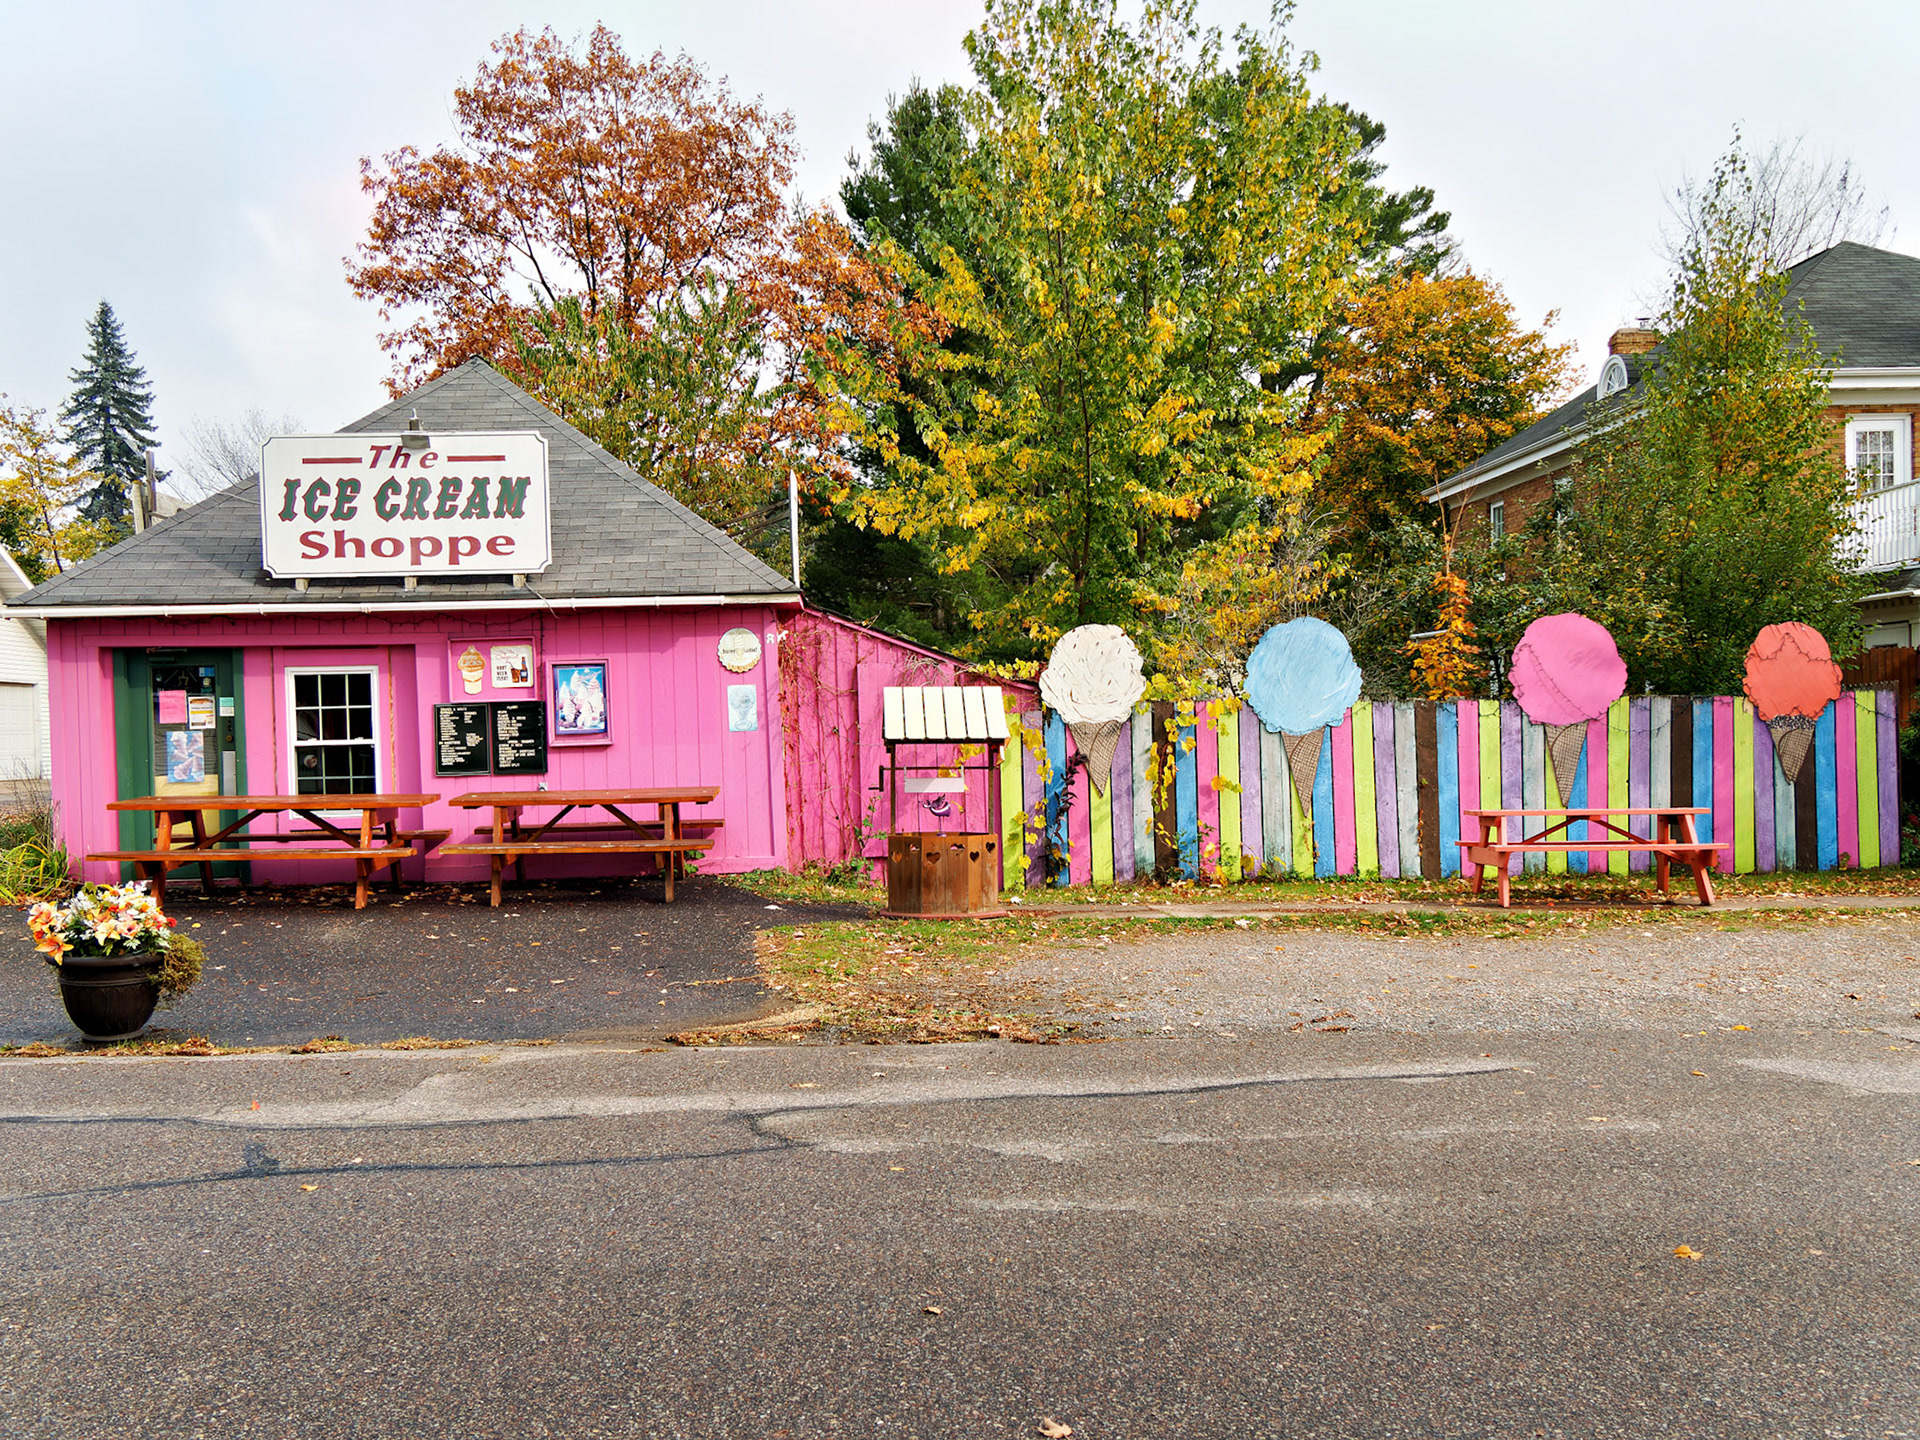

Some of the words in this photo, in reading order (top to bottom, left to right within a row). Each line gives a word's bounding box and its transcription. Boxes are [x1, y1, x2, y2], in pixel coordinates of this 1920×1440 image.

[369, 444, 439, 469] The
[278, 476, 361, 523] ICE
[373, 475, 531, 523] CREAM
[299, 529, 516, 566] Shoppe
